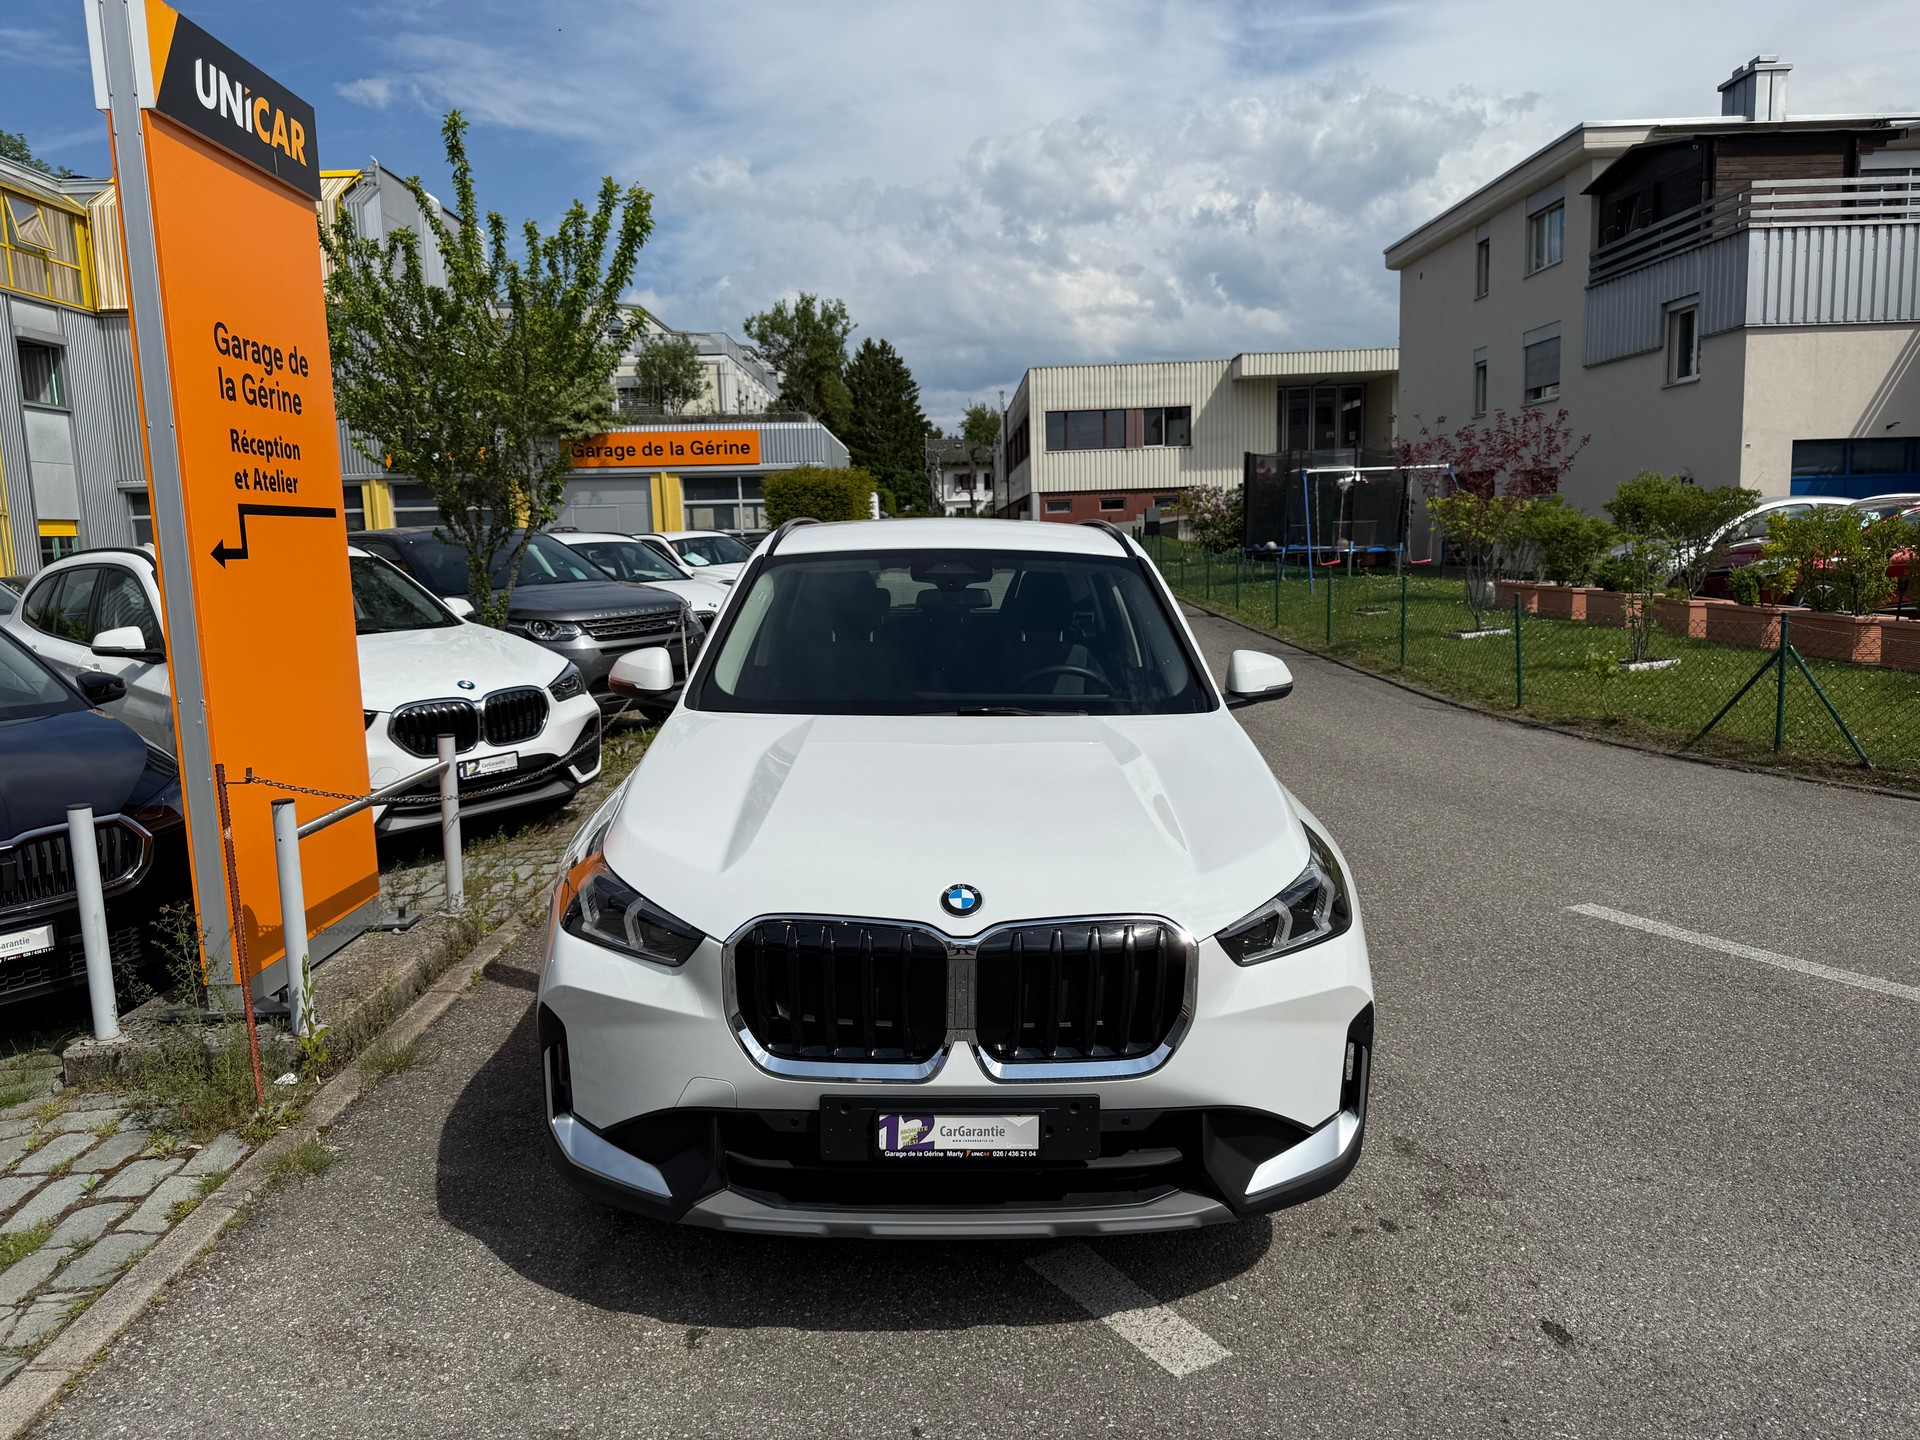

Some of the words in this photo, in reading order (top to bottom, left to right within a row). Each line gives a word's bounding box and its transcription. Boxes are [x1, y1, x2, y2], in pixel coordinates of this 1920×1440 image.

[213, 321, 284, 375] Garage
[288, 346, 309, 377] de
[217, 366, 237, 402] la
[241, 373, 303, 415] Gérine
[229, 428, 301, 463] Réception
[571, 442, 636, 461] Garage
[641, 441, 664, 456] de
[669, 440, 685, 456] la
[690, 439, 751, 456] Gérine
[234, 468, 250, 490] et
[253, 467, 299, 494] Atelier
[945, 884, 978, 894] BMW
[879, 1115, 935, 1150] 12
[940, 1126, 1005, 1136] CarGarantie
[884, 1150, 907, 1158] Garage
